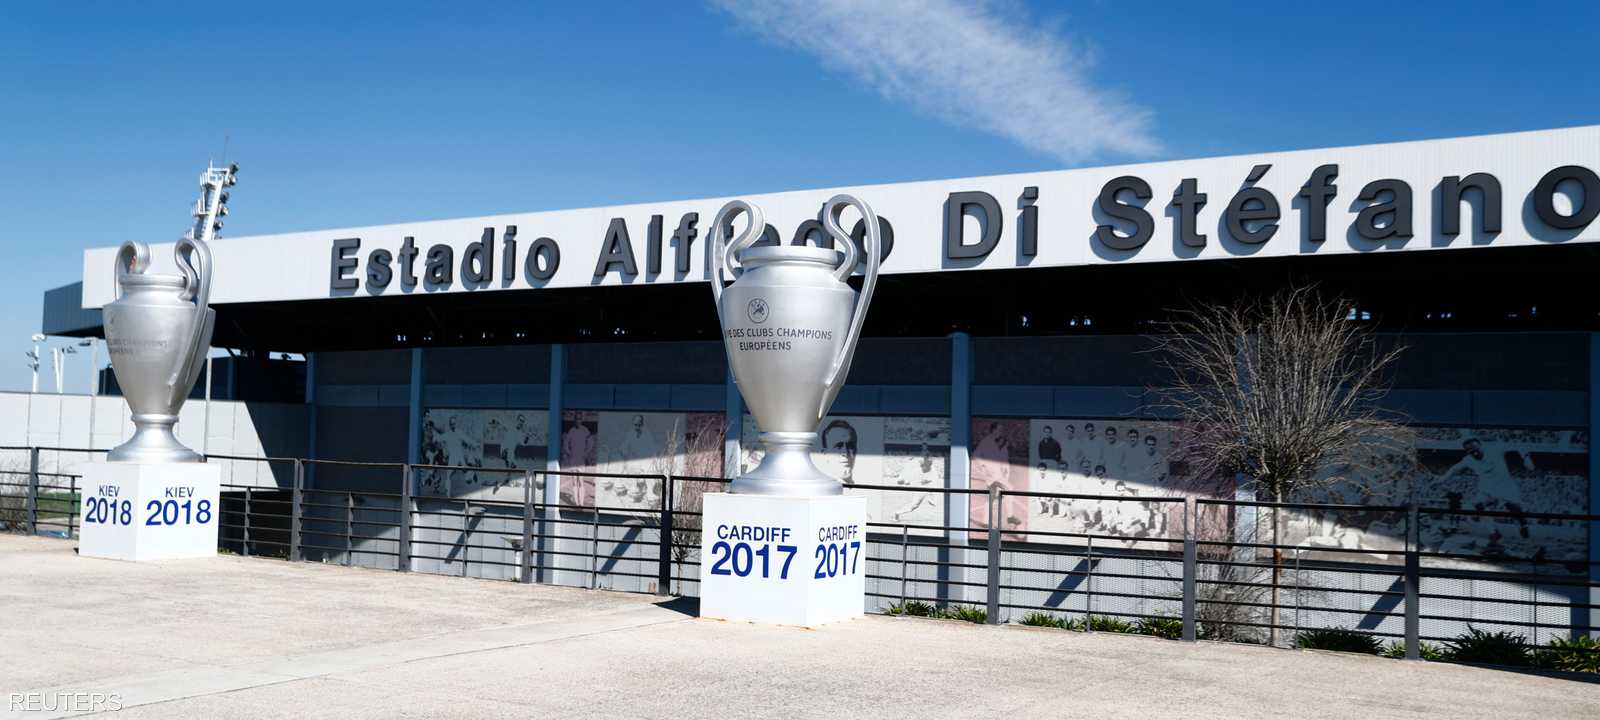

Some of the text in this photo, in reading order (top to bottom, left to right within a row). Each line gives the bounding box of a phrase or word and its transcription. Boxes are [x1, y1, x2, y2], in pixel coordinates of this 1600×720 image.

[331, 225, 560, 290] Estadio
[946, 186, 1038, 260] Di
[1096, 164, 1600, 251] Stéfano
[747, 328, 774, 337] CLUBS
[776, 327, 832, 340] CHAMPIONS
[98, 485, 120, 497] KIEV
[165, 487, 194, 498] KIEV
[85, 497, 132, 525] 2018
[145, 499, 212, 526] 2018
[717, 524, 791, 543] CARDIFF
[818, 525, 858, 542] CARDIFF
[710, 541, 798, 579] 2017
[814, 541, 861, 579] 2017
